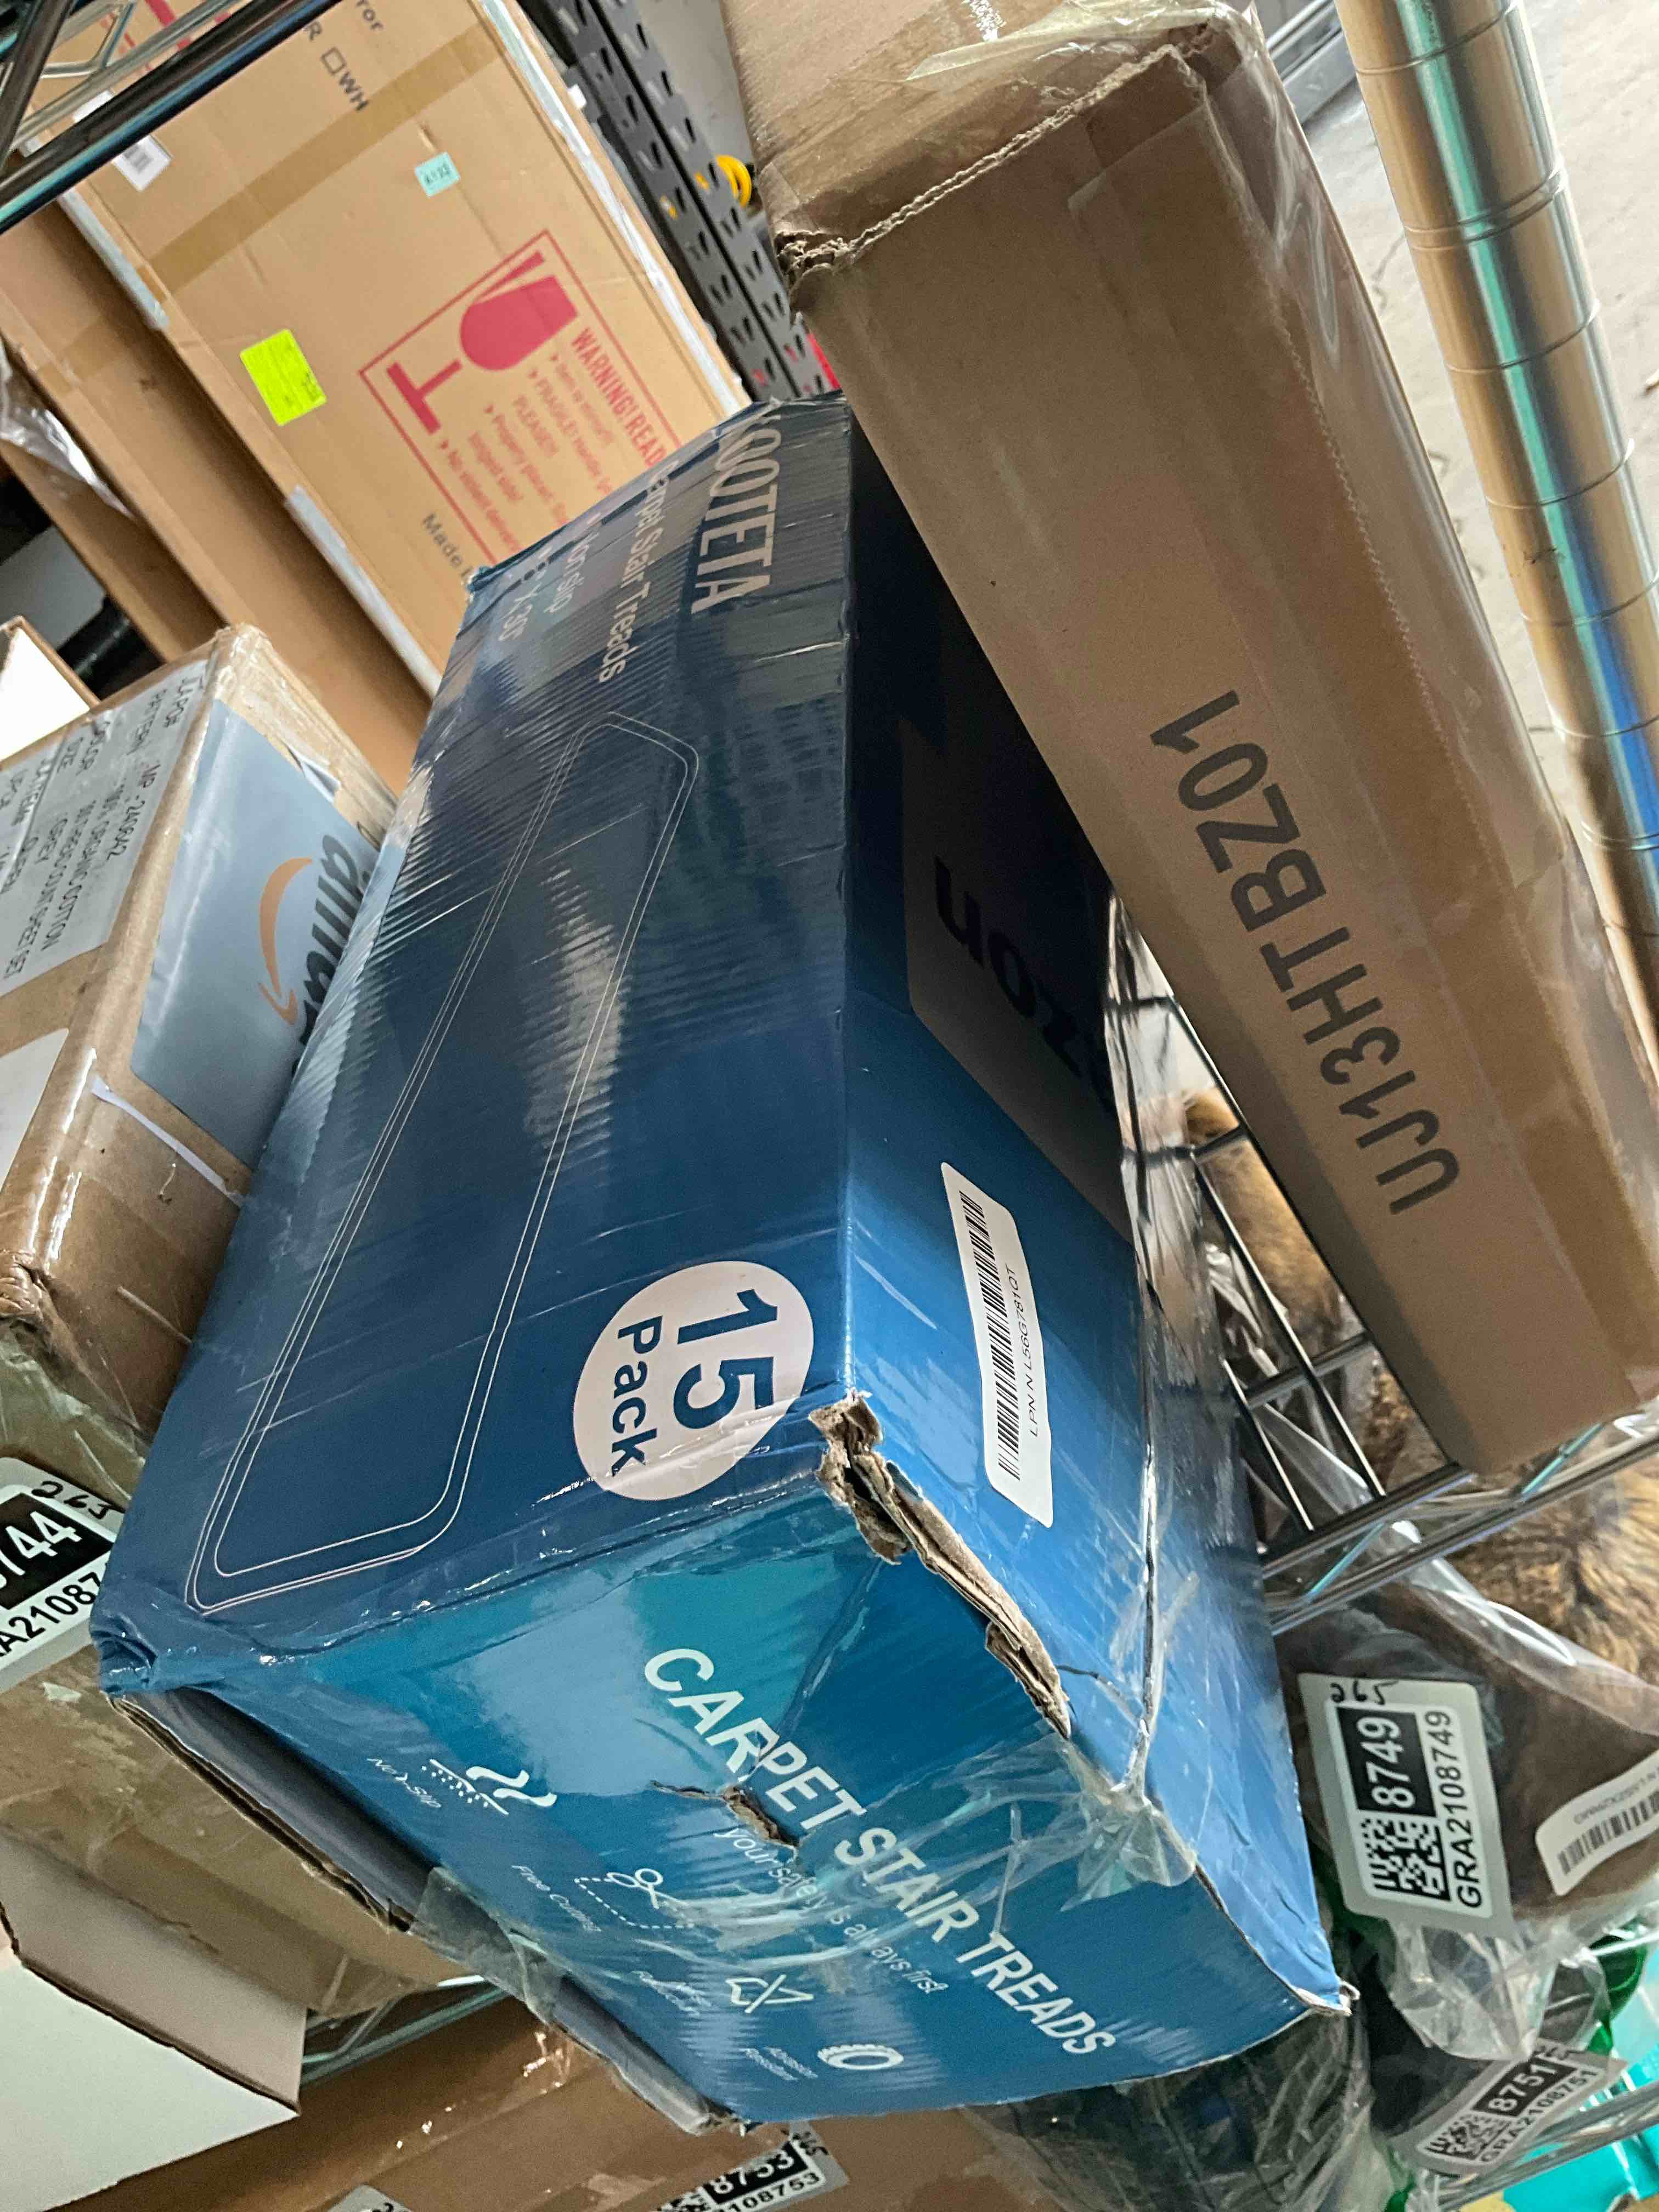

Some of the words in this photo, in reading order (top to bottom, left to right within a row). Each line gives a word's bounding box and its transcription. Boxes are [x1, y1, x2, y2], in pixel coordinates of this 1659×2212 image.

[422, 512, 463, 567] Made
[621, 526, 663, 588] Stair
[598, 581, 650, 683] Treads
[41, 884, 82, 951] COTTON
[1149, 690, 1460, 1216] UJ13HTBZ01
[611, 1316, 663, 1477] Pack
[674, 1289, 778, 1429] 15
[644, 1648, 867, 1830] CARPET
[1330, 1680, 1400, 1705] 265
[1357, 1716, 1416, 1809] 8749
[714, 1827, 779, 1864] your
[1424, 1711, 1482, 1908] GRA2108749
[834, 1827, 980, 1943] STAIR
[956, 1930, 1116, 2054] TREADS
[1482, 2069, 1598, 2162] GRA2108751
[1488, 2063, 1556, 2112] 8751
[718, 2171, 821, 2212] 108753
